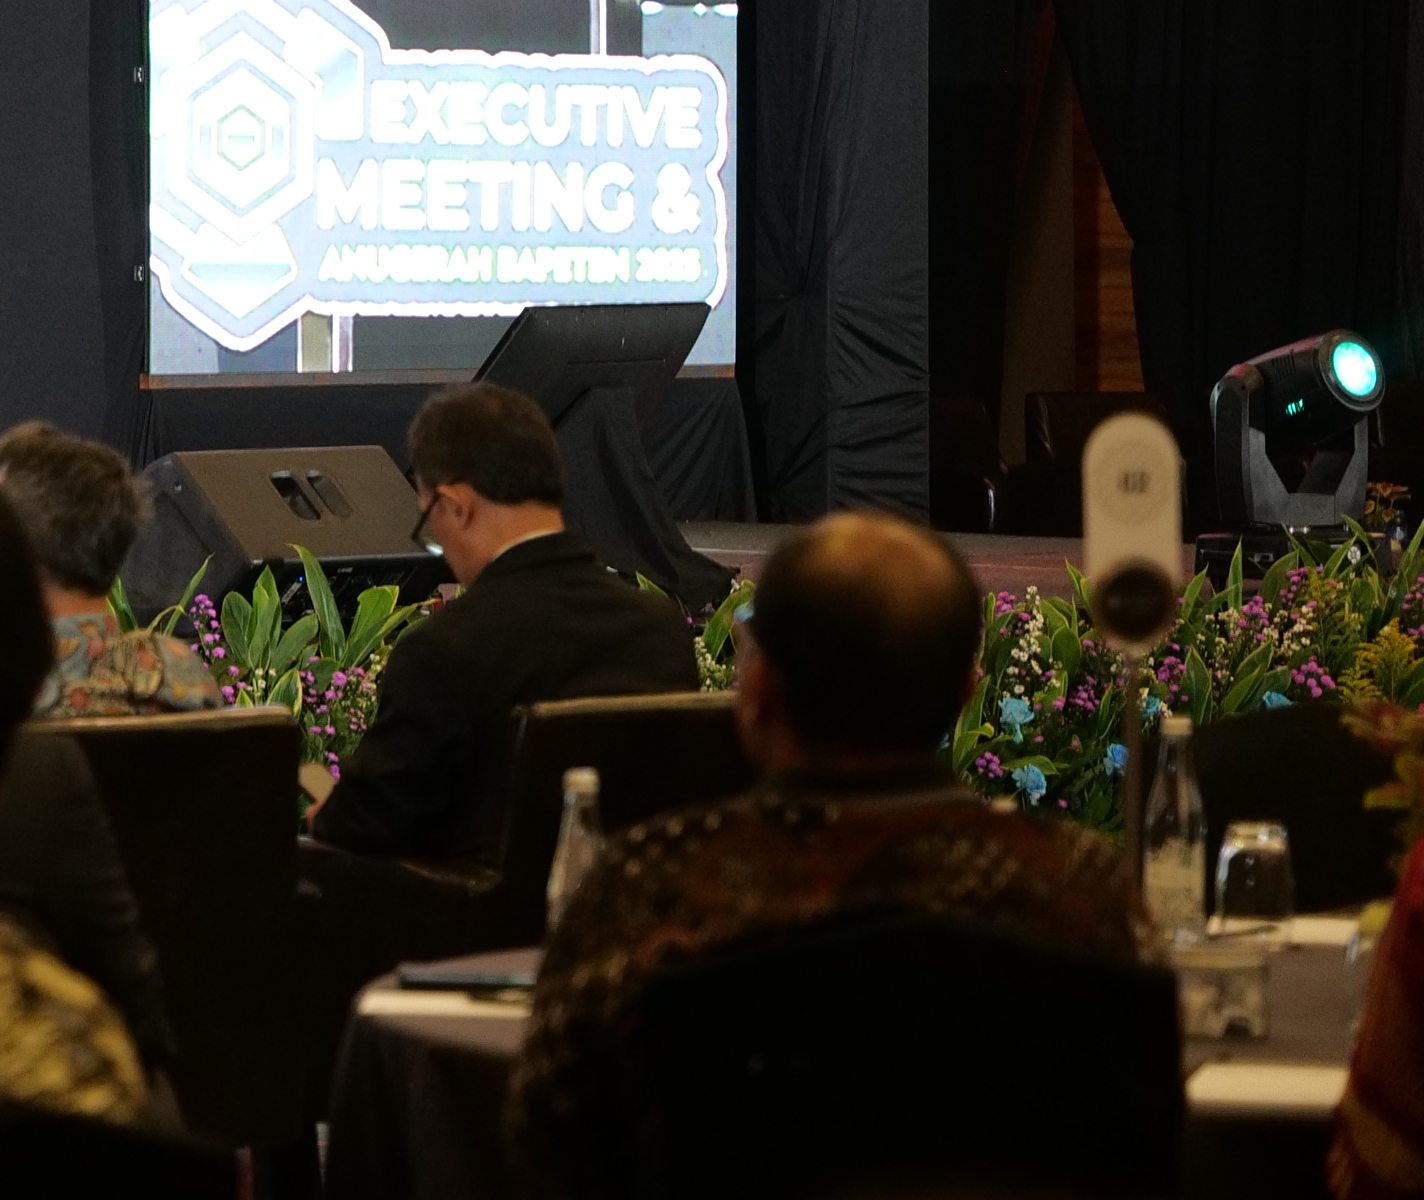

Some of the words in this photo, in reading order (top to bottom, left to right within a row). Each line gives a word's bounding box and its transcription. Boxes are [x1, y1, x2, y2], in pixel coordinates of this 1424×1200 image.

[370, 80, 703, 149] EXECUTIVE
[316, 157, 635, 234] MEETING
[651, 162, 702, 235] &
